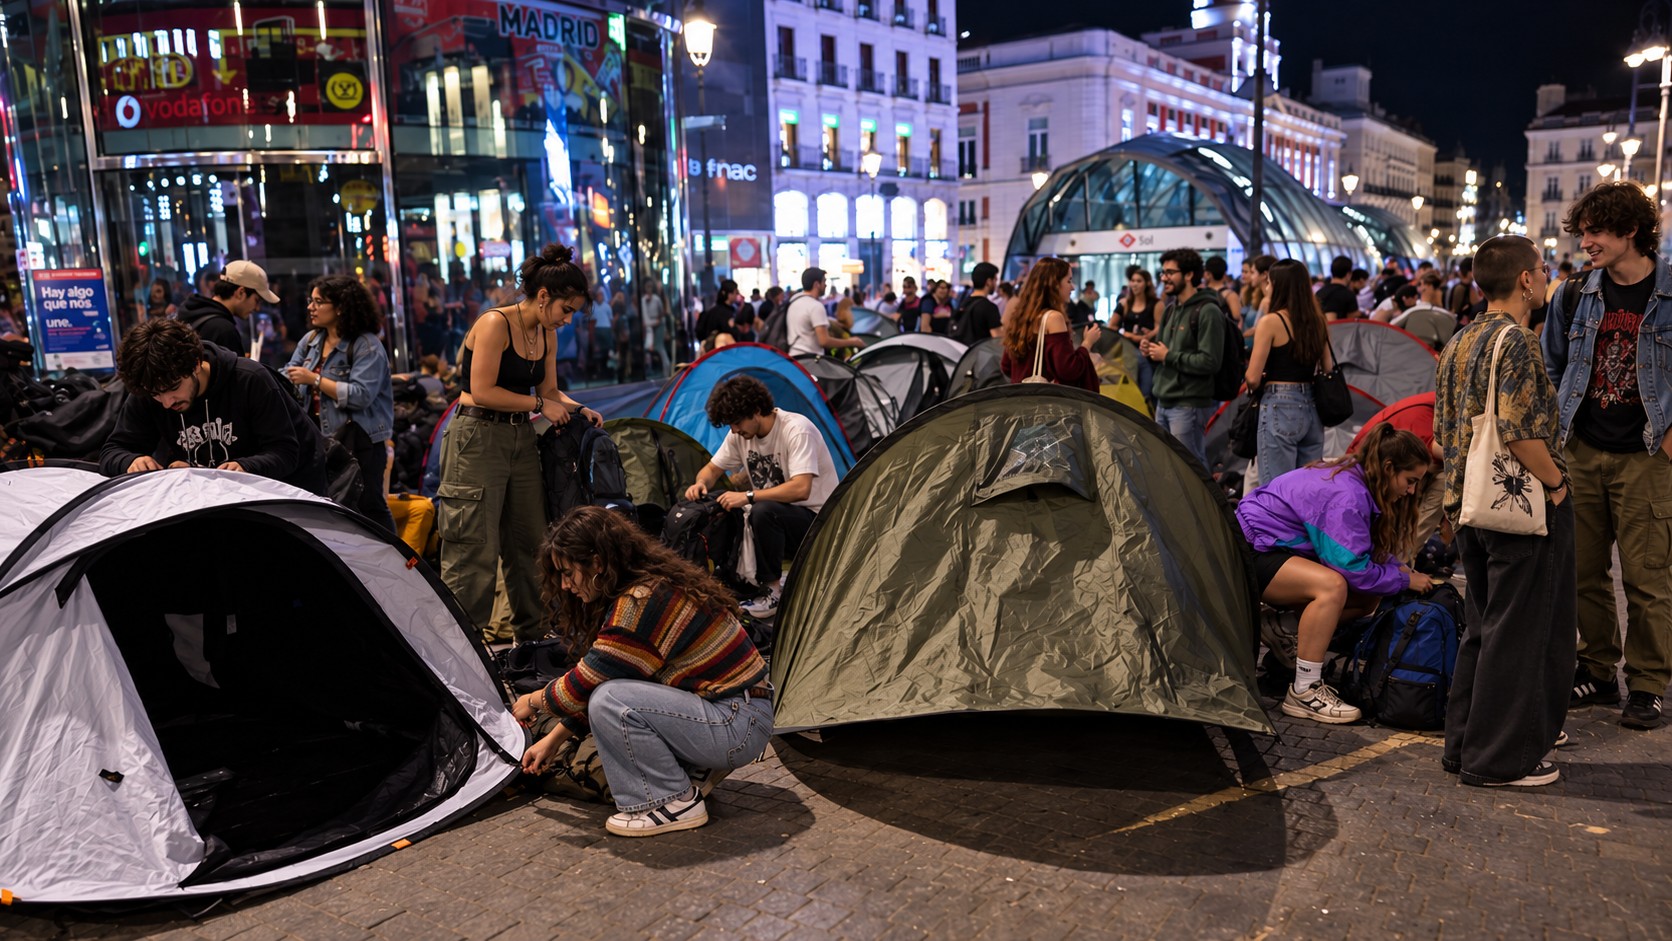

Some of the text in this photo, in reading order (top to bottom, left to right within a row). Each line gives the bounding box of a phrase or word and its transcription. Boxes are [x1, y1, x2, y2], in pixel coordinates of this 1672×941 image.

[499, 4, 599, 49] MADRID
[147, 93, 256, 118] vodafone
[706, 158, 758, 182] fnac
[1139, 235, 1154, 245] Sol
[41, 286, 94, 299] Hay algo
[44, 300, 67, 311] que
